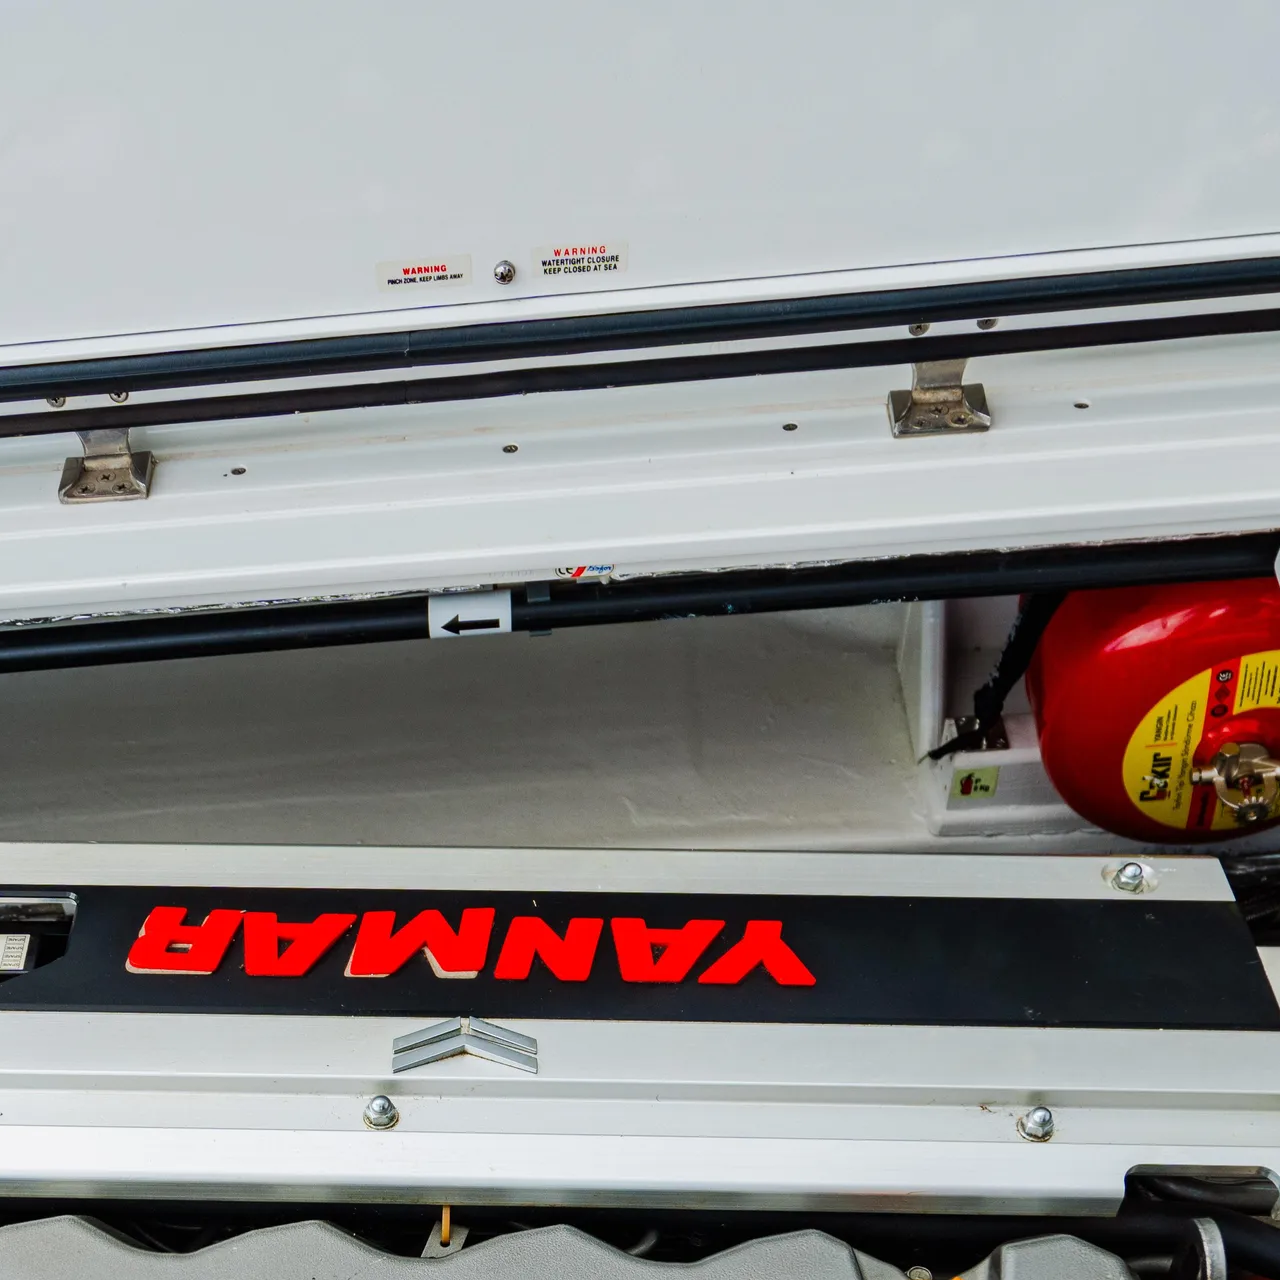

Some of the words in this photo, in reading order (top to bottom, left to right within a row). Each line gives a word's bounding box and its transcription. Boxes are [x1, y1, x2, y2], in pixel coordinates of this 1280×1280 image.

[554, 245, 606, 257] WARNING
[541, 257, 585, 267] WATERTIGHT
[587, 255, 619, 264] CLOSURE
[402, 265, 447, 275] WARNING
[544, 266, 561, 275] KEEP
[563, 265, 592, 273] CLOSED
[604, 263, 617, 271] SEA
[124, 905, 818, 988] YANMAR
